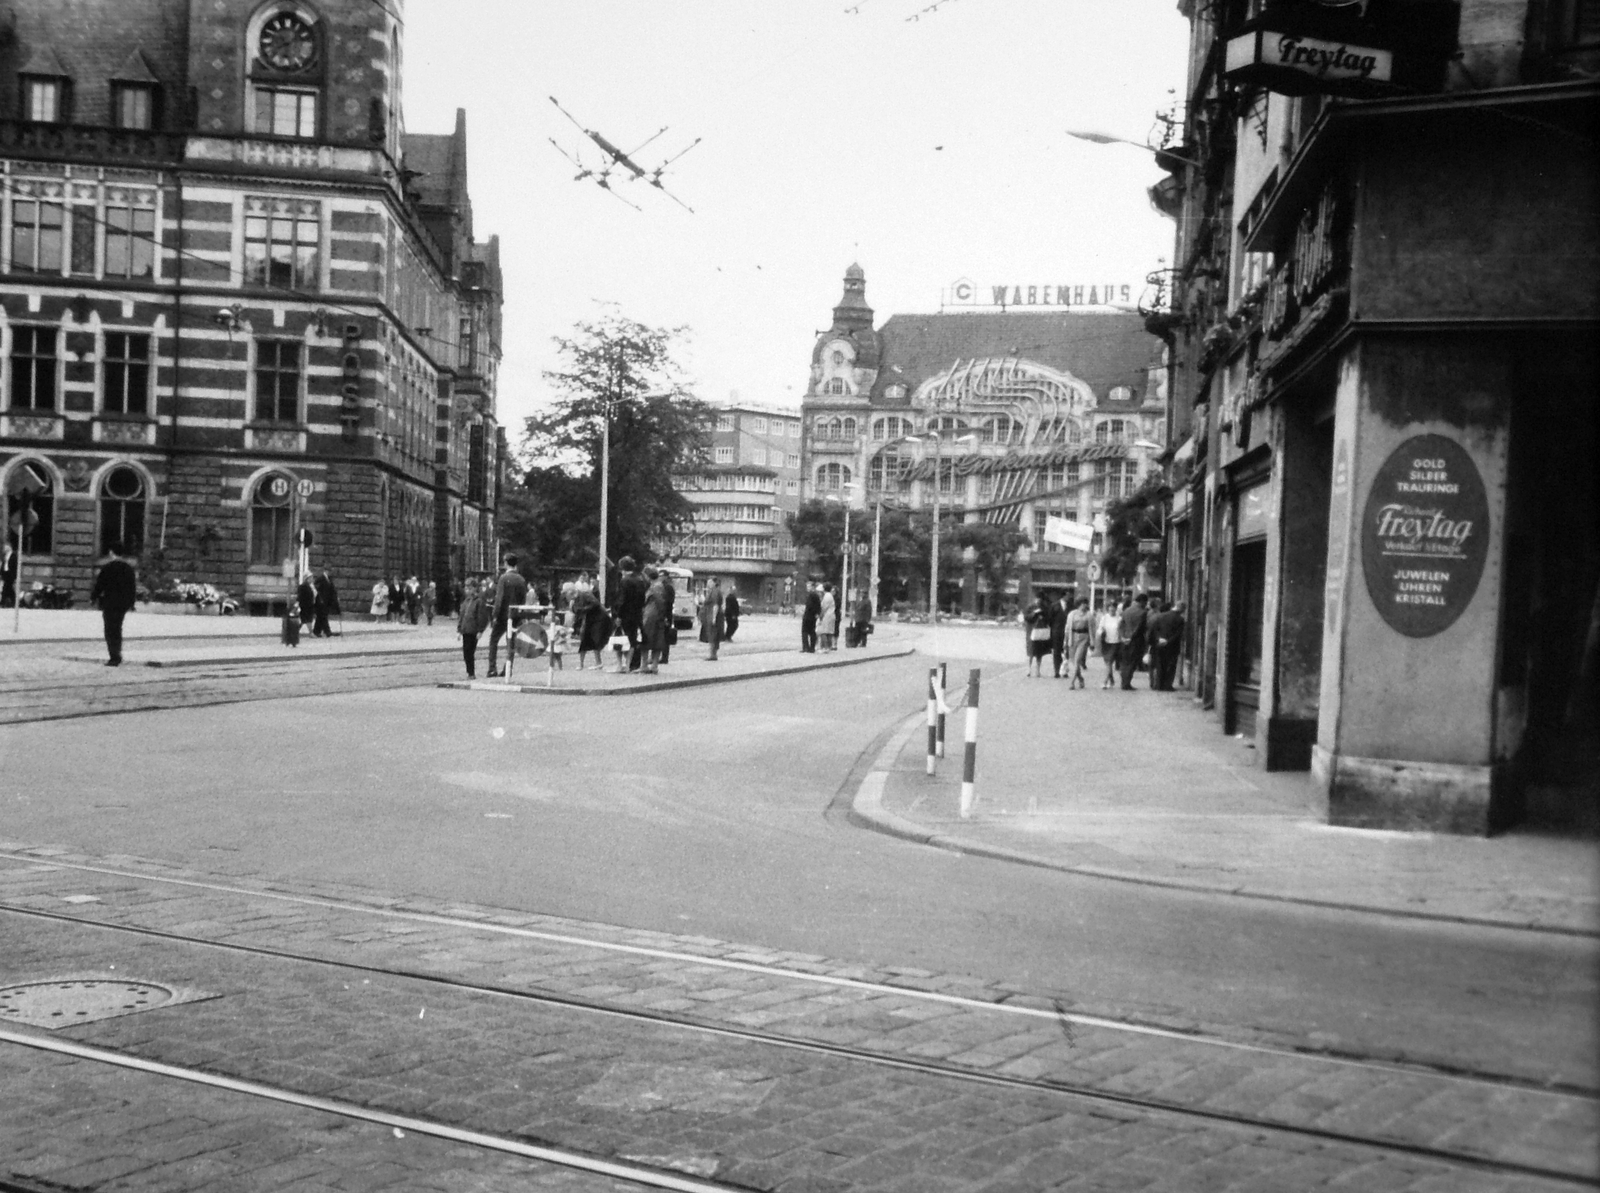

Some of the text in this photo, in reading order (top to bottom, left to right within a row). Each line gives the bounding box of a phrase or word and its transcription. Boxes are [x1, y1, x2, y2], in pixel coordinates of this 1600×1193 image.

[1279, 33, 1376, 78] Freytag
[992, 285, 1131, 305] WARENHAUS
[342, 321, 361, 440] POST
[1413, 459, 1446, 469] GOLD
[1410, 470, 1448, 481] SILBER
[1397, 482, 1459, 494] TRAURINGE
[1377, 504, 1473, 546] Freytag
[1394, 570, 1450, 581] JUWELEN
[1400, 582, 1442, 592] UHREN
[1396, 594, 1446, 606] KRISTALL
